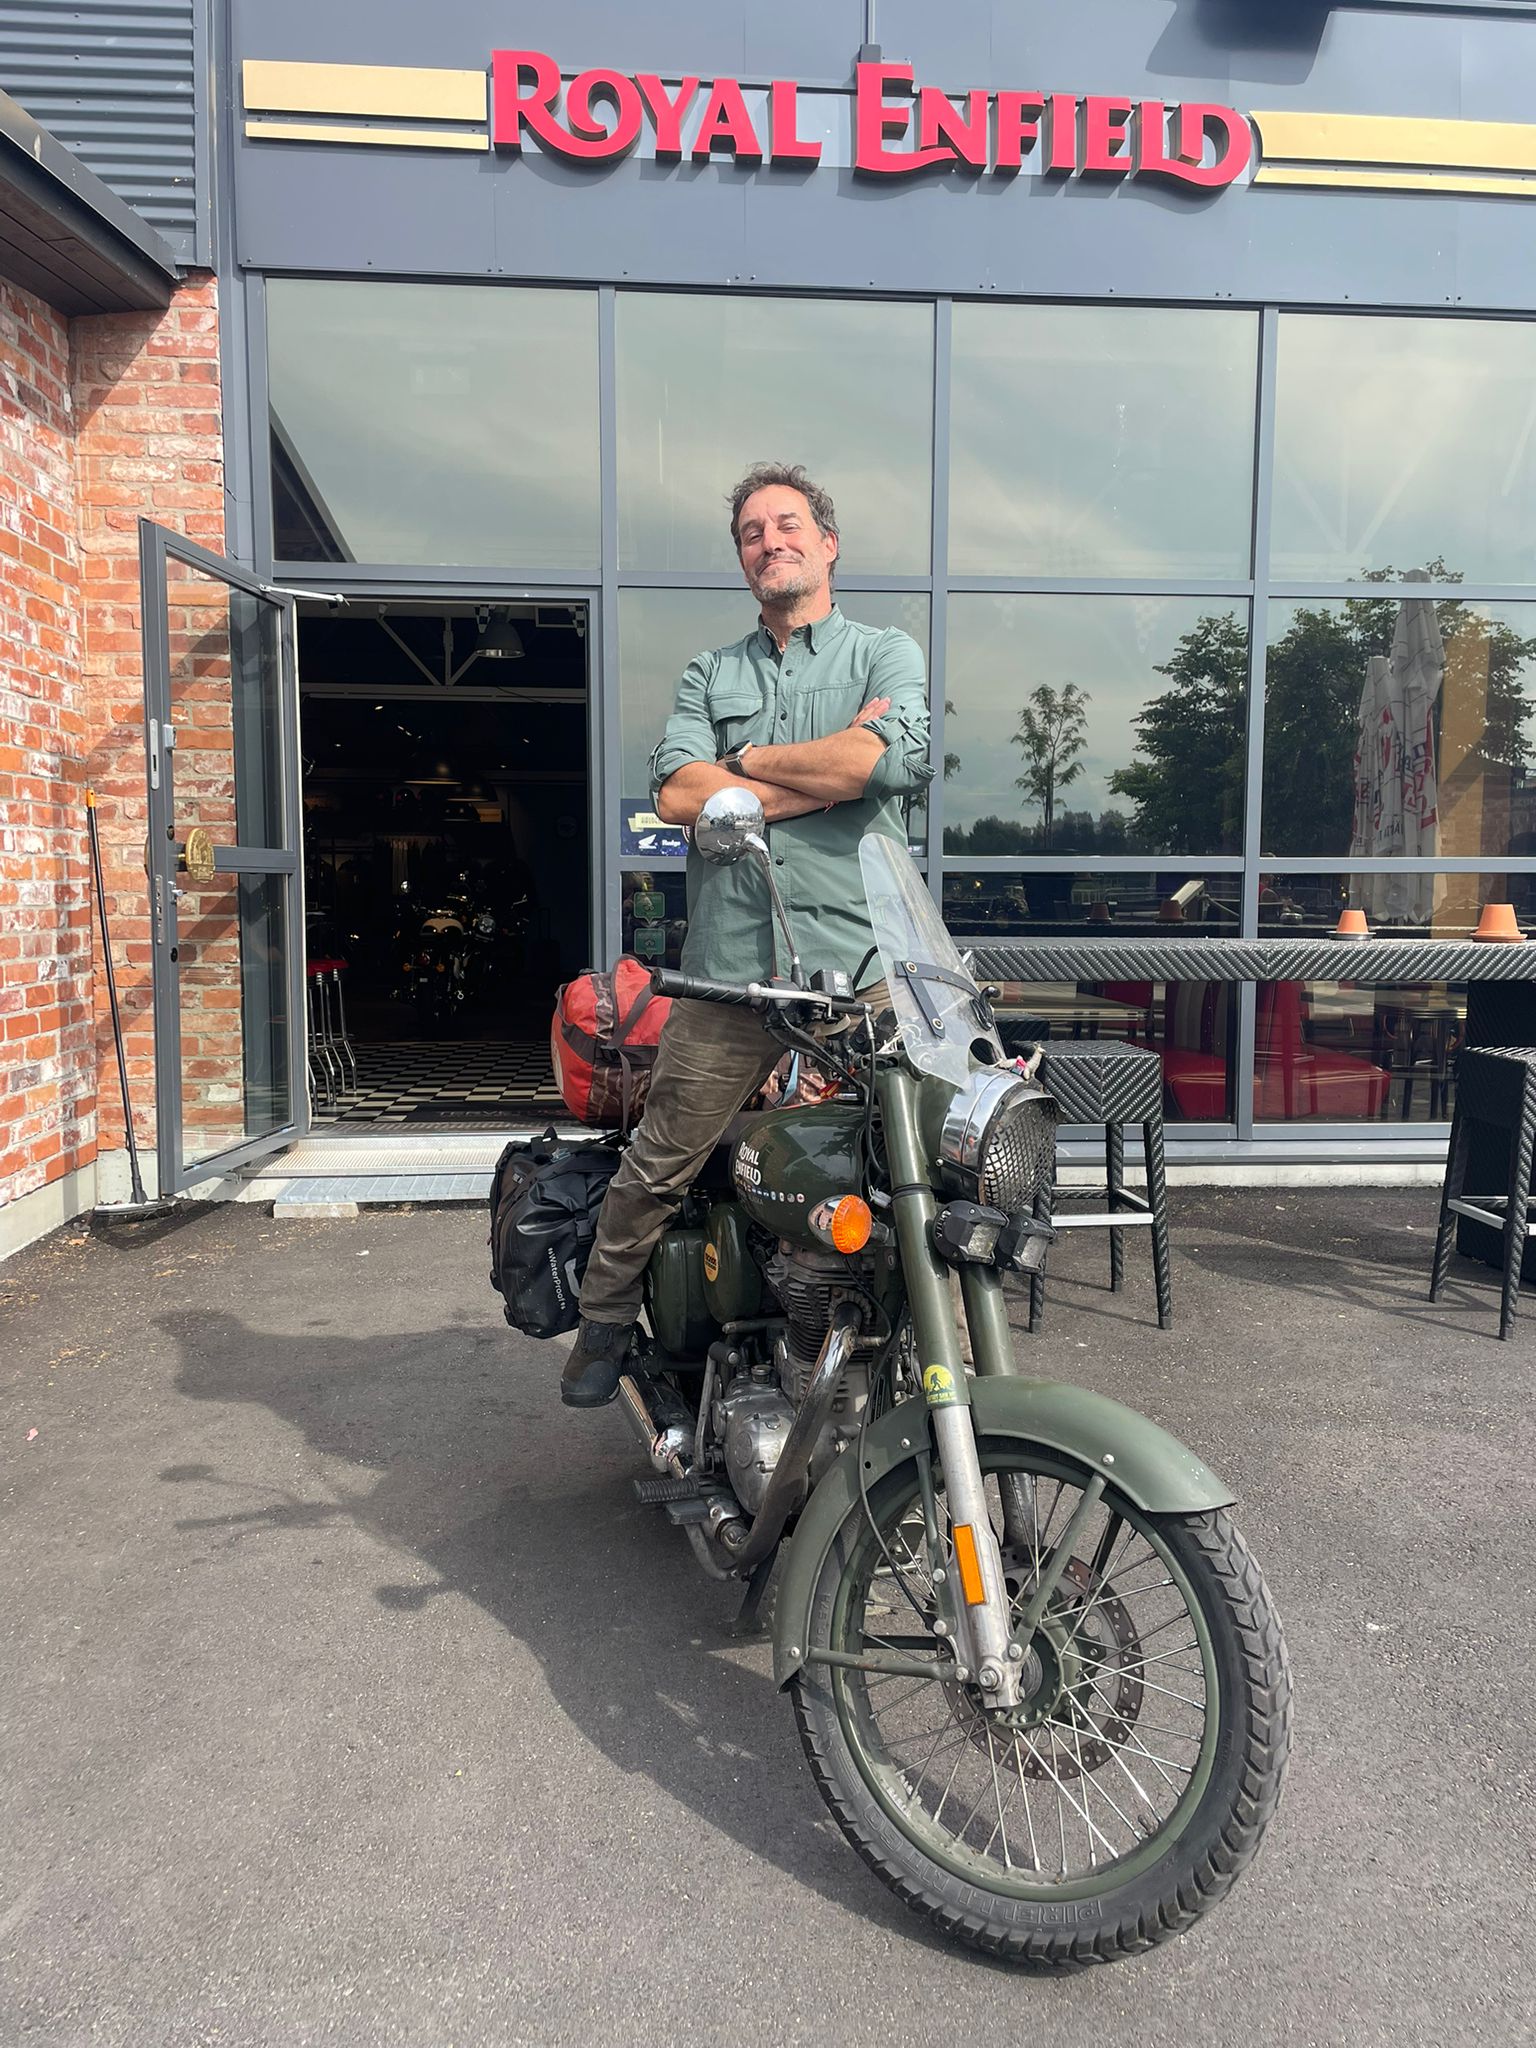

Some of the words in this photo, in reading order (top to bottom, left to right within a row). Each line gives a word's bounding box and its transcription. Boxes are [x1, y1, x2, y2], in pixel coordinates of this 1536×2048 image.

[491, 49, 824, 163] ROYAL
[855, 62, 1253, 188] ENFIELD
[738, 1141, 760, 1166] ROYAL
[958, 1887, 1103, 1926] PIRELLI
